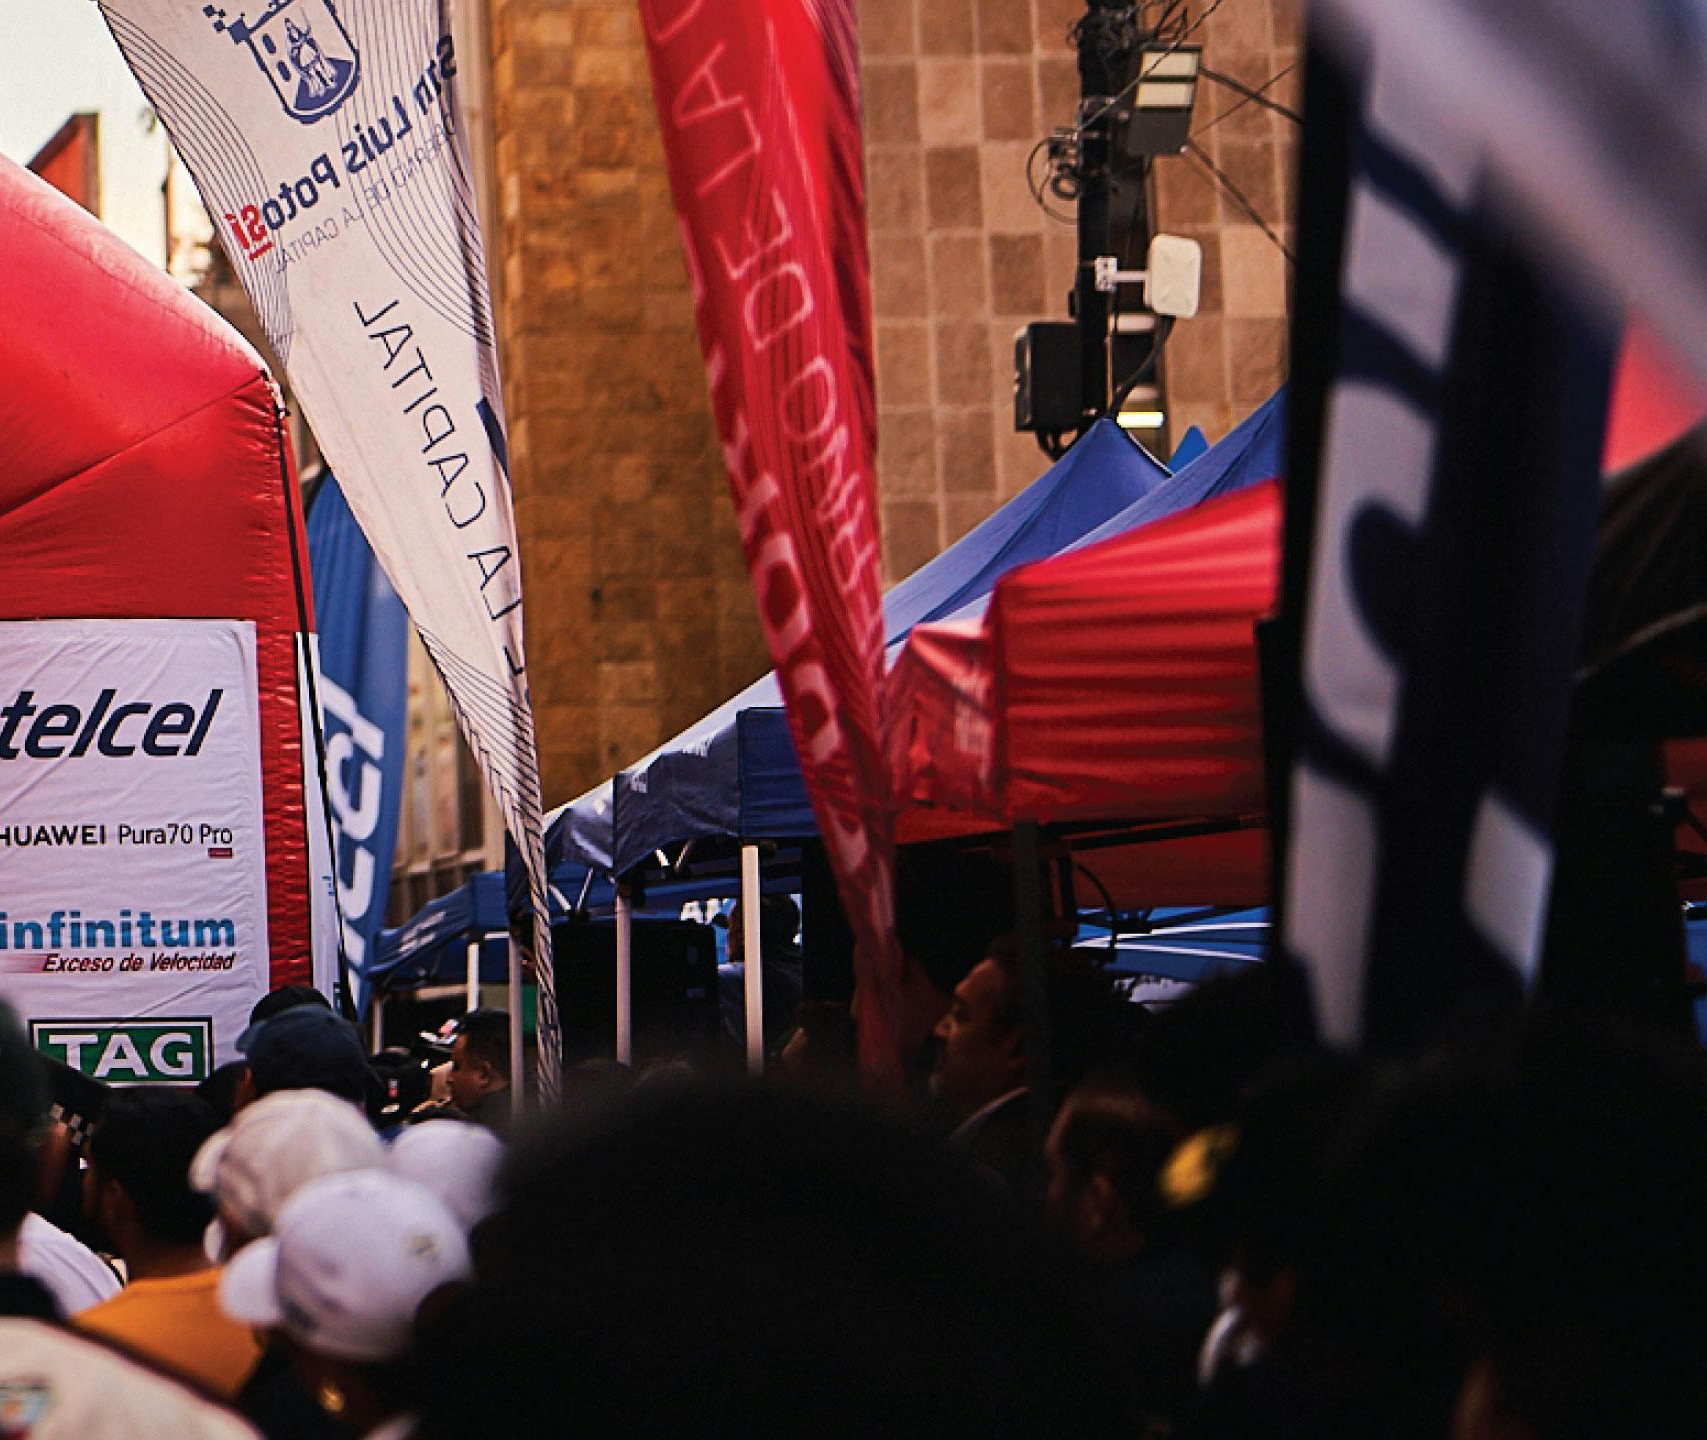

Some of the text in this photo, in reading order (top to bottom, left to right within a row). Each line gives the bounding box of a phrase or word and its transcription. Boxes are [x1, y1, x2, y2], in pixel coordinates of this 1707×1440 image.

[118, 823, 193, 845] Pura70
[199, 823, 233, 845] Pro
[42, 951, 237, 972] Exceso de Velocidad
[48, 1032, 194, 1078] TAG
